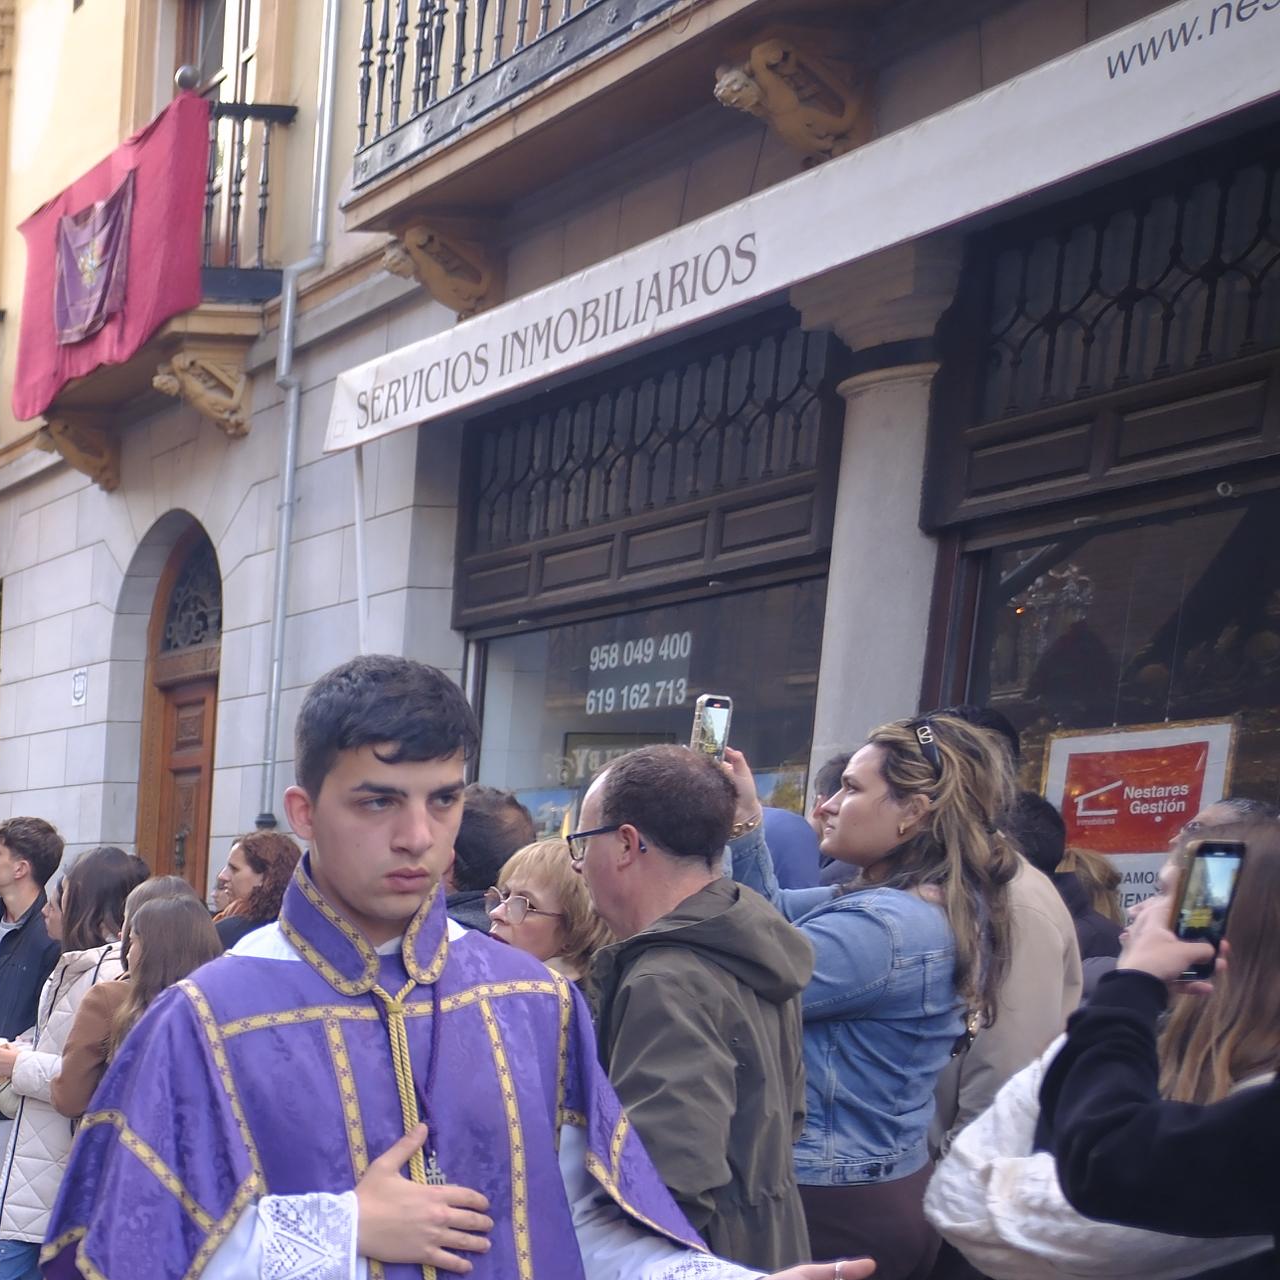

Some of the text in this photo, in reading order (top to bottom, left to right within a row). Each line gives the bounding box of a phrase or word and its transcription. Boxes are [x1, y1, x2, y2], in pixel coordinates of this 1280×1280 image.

[356, 232, 758, 429] SERVICIOS INMOBILIARIOS
[589, 631, 692, 672] 958 049 400
[585, 677, 687, 715] 619 162 713
[1123, 783, 1190, 800] Nestares
[1129, 798, 1186, 815] Gestión
